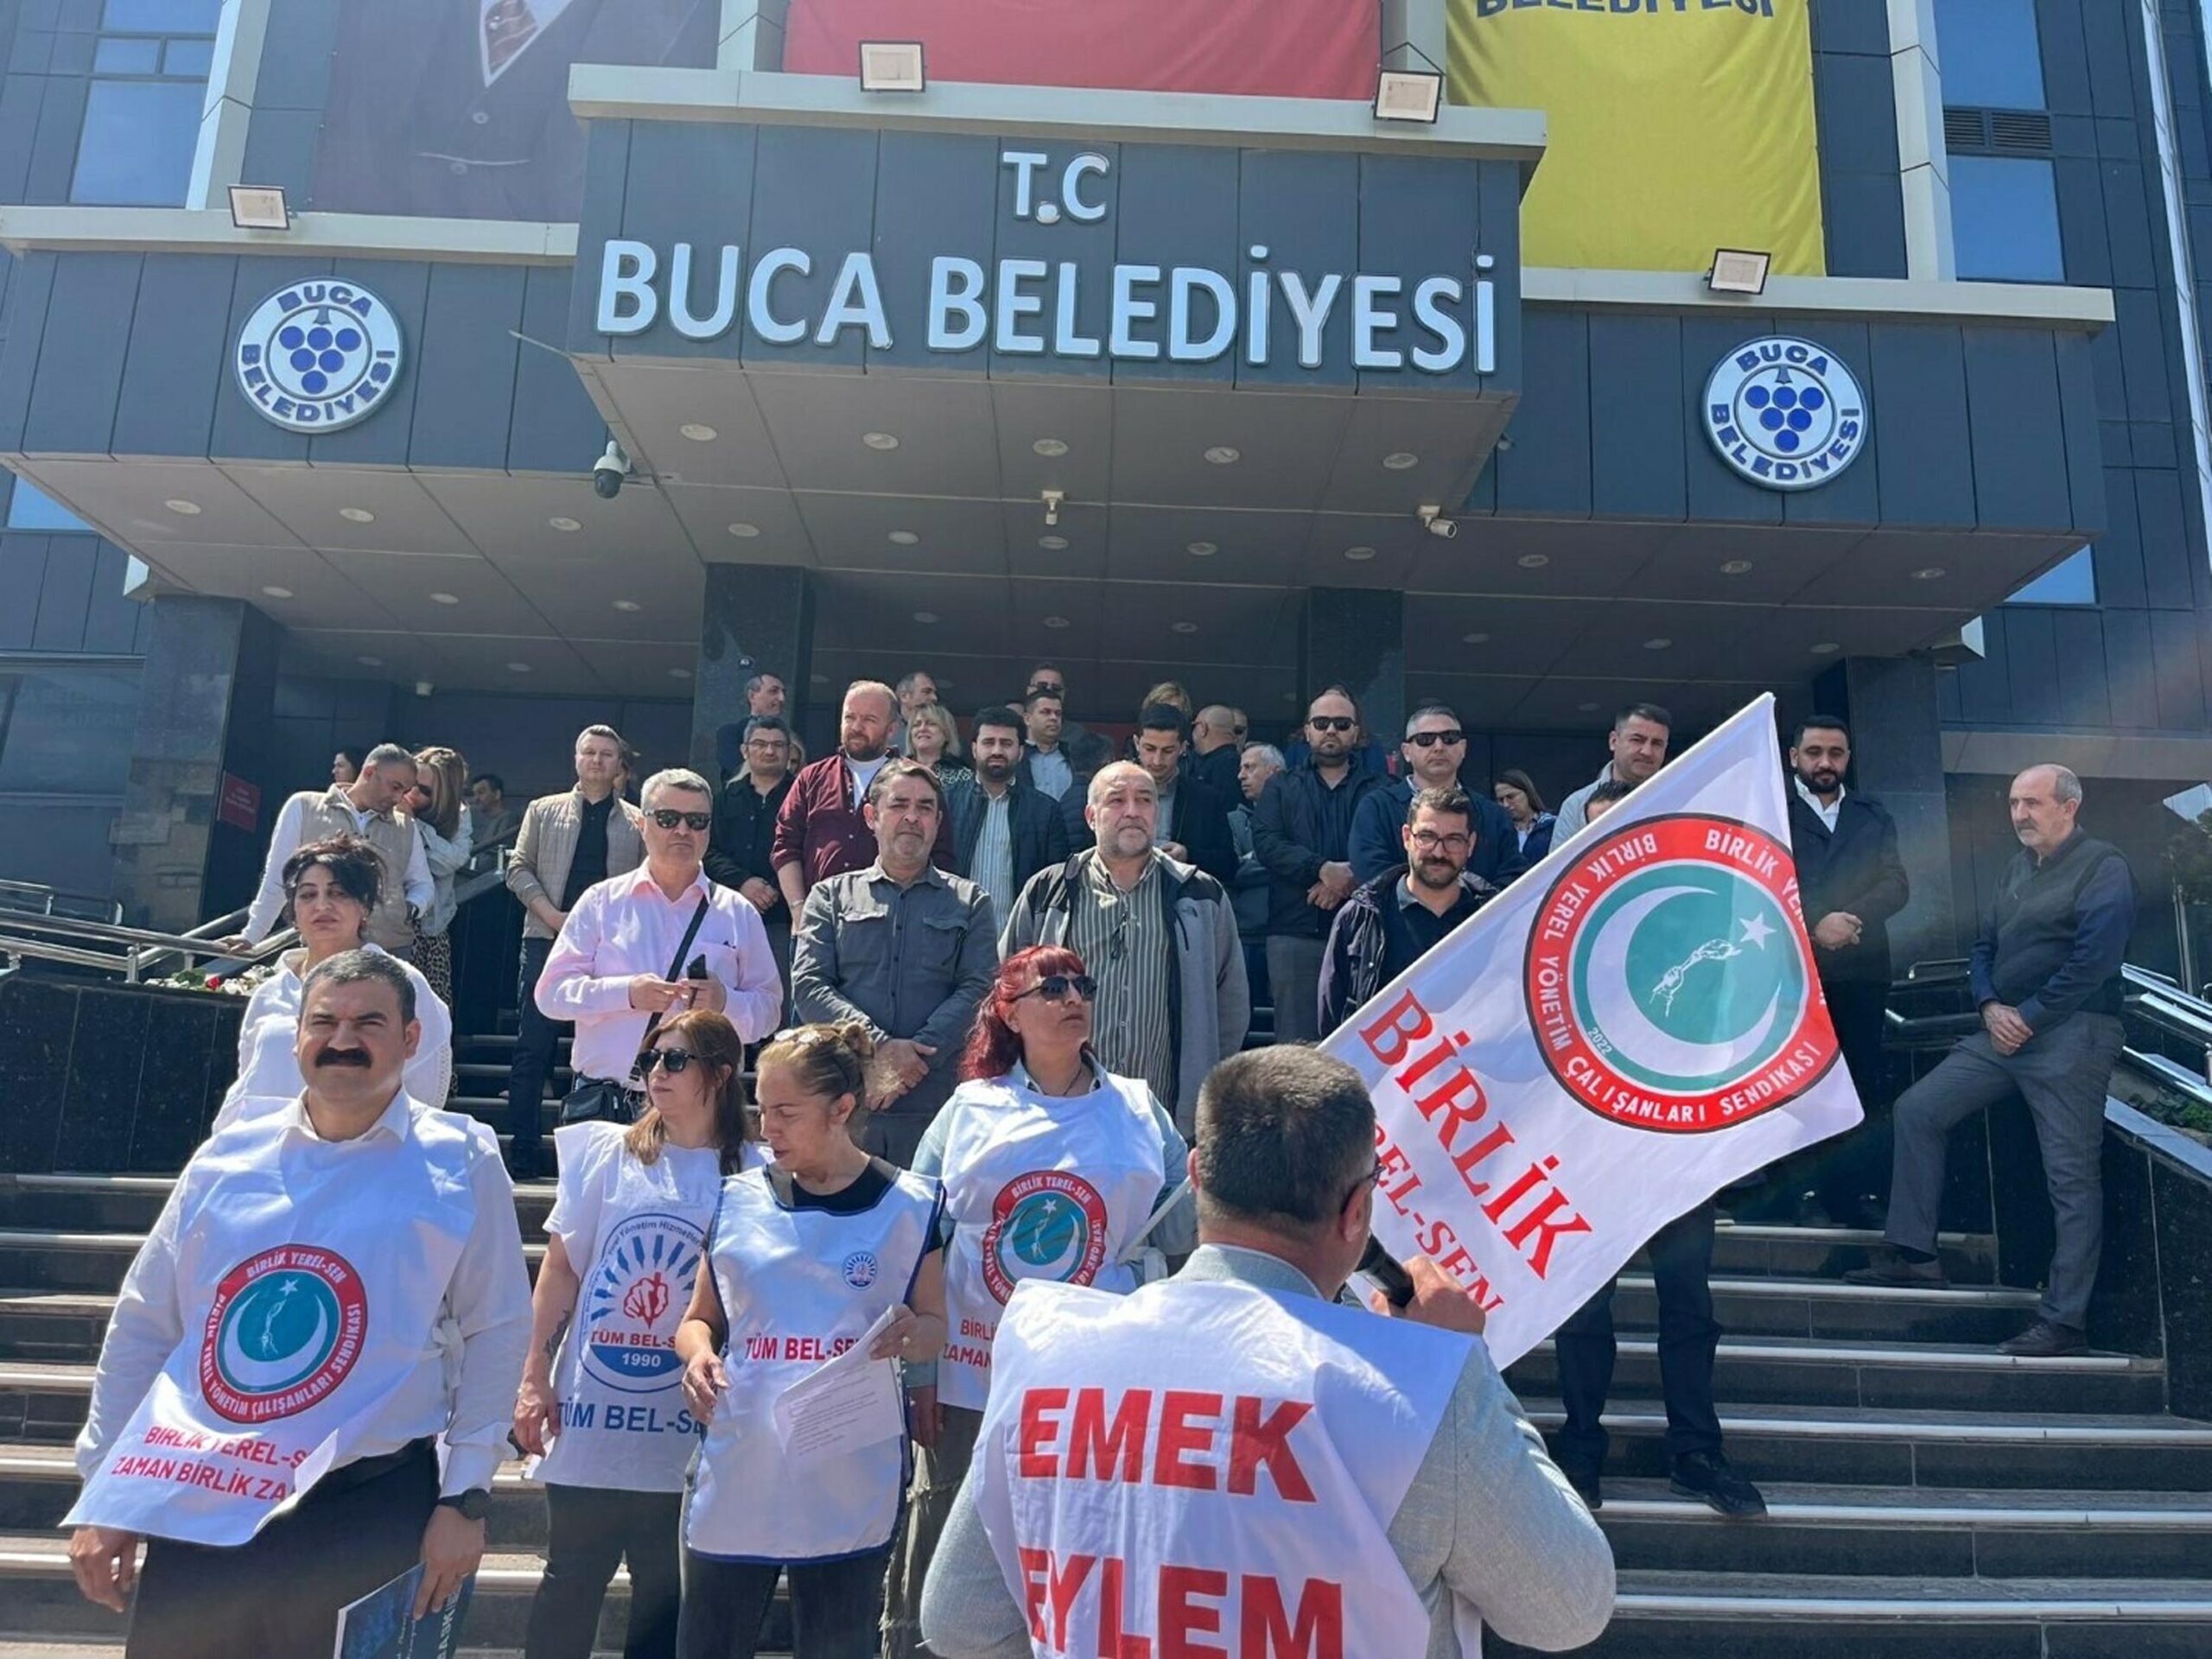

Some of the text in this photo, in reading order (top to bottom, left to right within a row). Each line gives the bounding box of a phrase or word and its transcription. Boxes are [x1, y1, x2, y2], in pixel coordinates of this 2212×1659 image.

[1002, 151, 1110, 224] T.C
[276, 284, 372, 318] BUCA
[596, 238, 1497, 373] BUCA BELEDİYESİ
[1736, 344, 1828, 377] BUCA
[1586, 834, 1657, 882] BİRLİK
[1705, 828, 1779, 879] BİRLİK
[1543, 882, 1591, 940] YEREL
[1538, 957, 1573, 1052] YÖNETİM
[1588, 1027, 1613, 1056] 2022
[1719, 1041, 1821, 1116] SENDİKASI
[1358, 988, 1592, 1281] BİRLİK
[245, 1250, 347, 1284] BİRLİK YEREL-SEN
[331, 1303, 361, 1374] SENDİKASI
[745, 1332, 860, 1360] TÜM BEL-SE
[960, 1316, 997, 1342] BİRLİ
[621, 1352, 662, 1369] 1990
[1018, 1387, 1318, 1503] EMEK
[175, 1459, 254, 1497] BİRLİK
[1018, 1546, 1344, 1659] EYLEM
